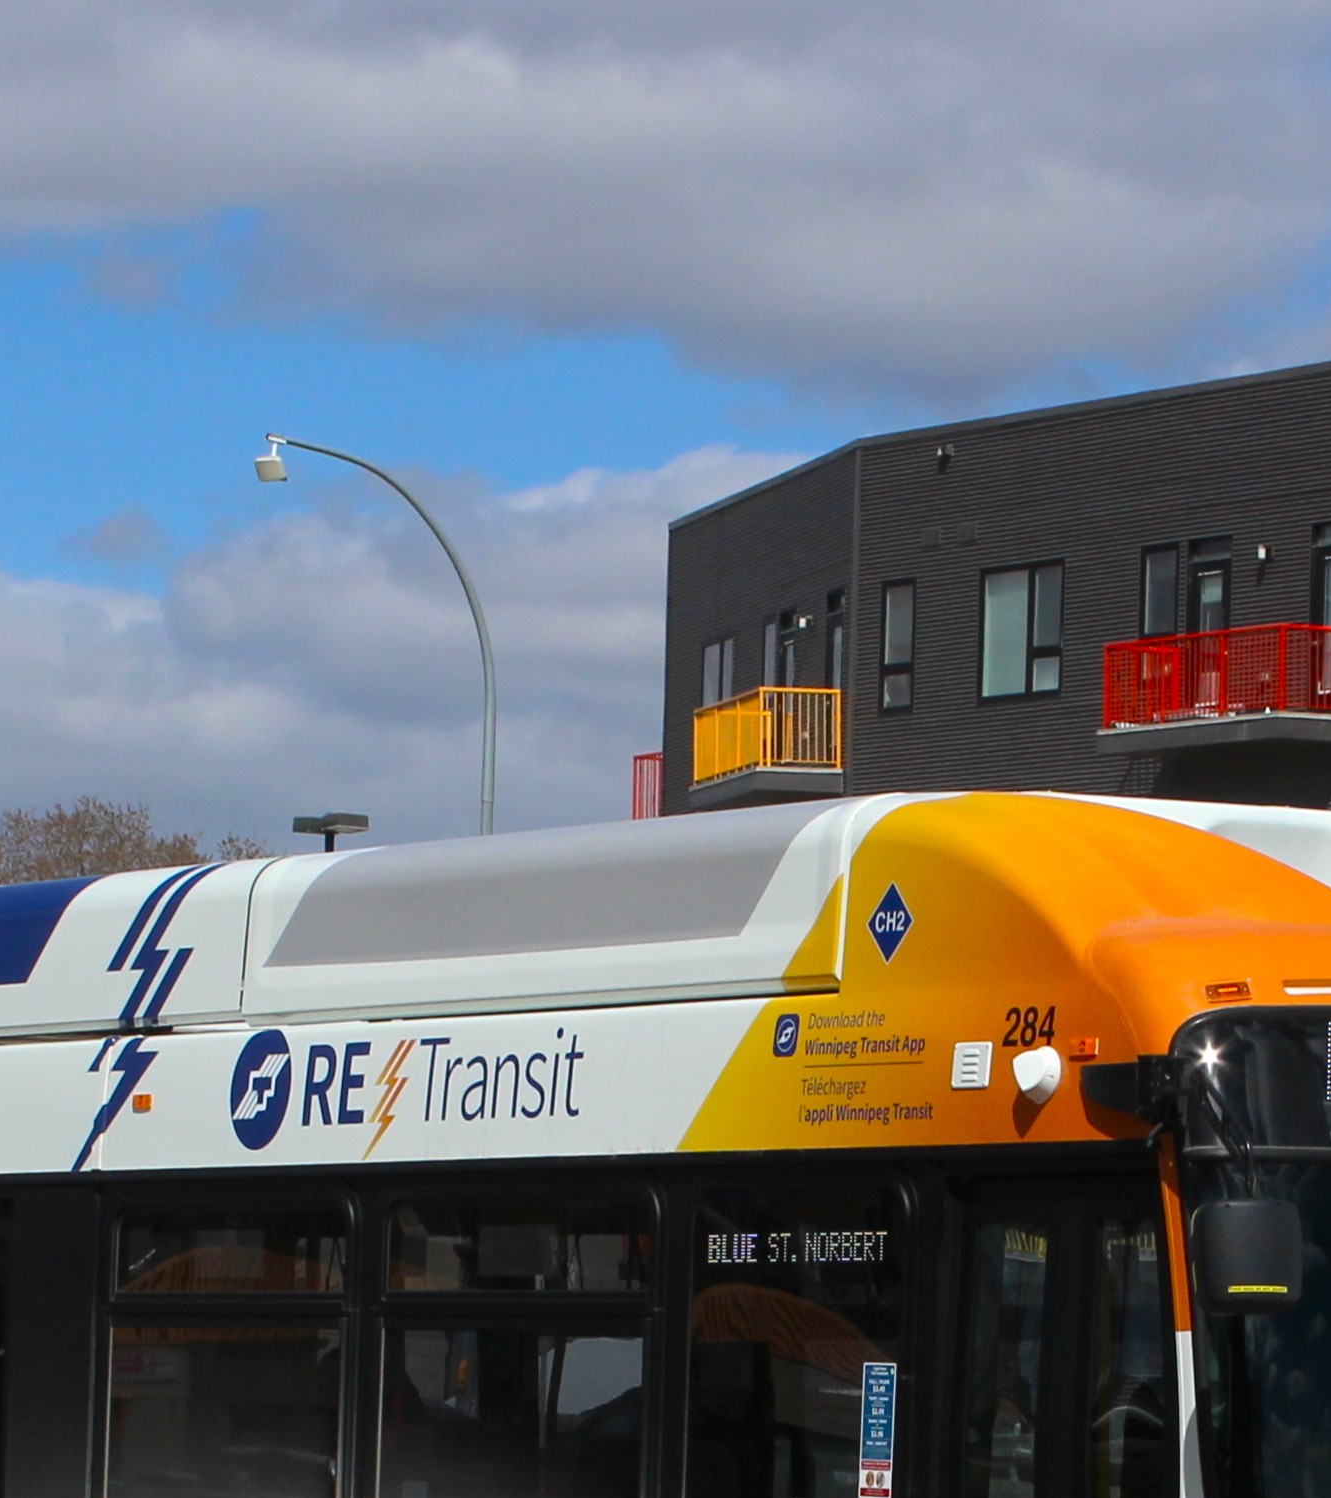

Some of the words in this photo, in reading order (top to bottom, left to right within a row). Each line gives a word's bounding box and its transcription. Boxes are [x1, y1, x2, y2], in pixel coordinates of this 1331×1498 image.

[875, 911, 905, 933] CH2
[808, 1011, 865, 1030] Download
[866, 1009, 885, 1027] the
[1002, 1006, 1056, 1047] 284
[805, 1037, 858, 1060] Winnipeg
[861, 1034, 900, 1054] Transit
[902, 1035, 926, 1056] App
[301, 1041, 372, 1127] RE
[420, 1027, 585, 1123] Transit
[801, 1076, 867, 1100] Téléchargez
[799, 1104, 834, 1127] l'appli
[836, 1103, 891, 1126] Winnipeg
[892, 1101, 934, 1121] Transit
[708, 1233, 758, 1263] BLUE
[768, 1233, 796, 1262] ST.
[805, 1231, 887, 1262] NORBERT
